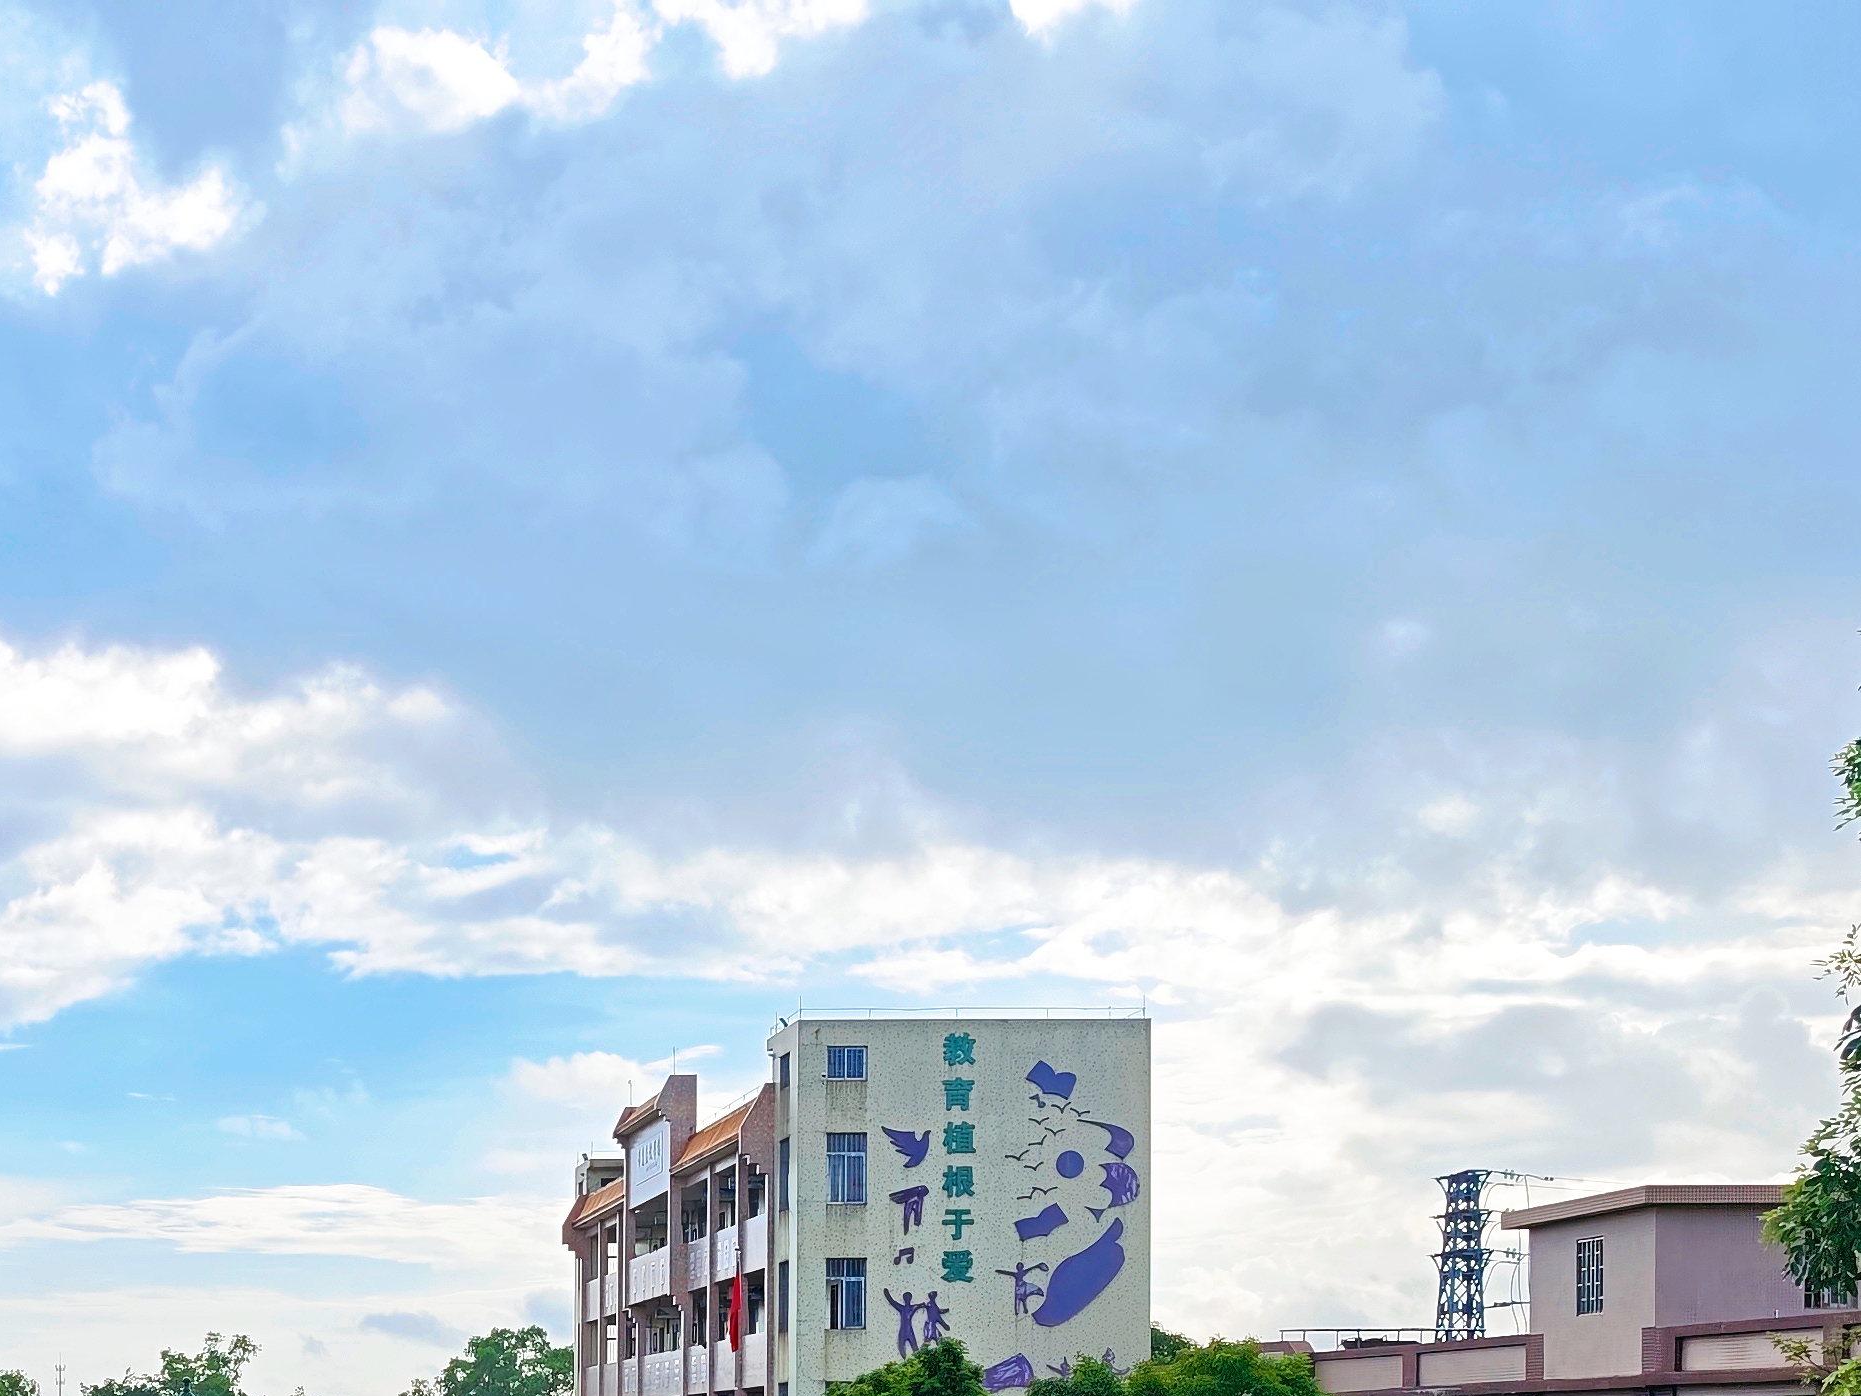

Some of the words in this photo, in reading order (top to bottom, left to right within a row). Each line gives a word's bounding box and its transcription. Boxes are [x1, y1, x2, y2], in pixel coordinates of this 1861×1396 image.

[942, 1032, 976, 1283] 教育植根于爱
